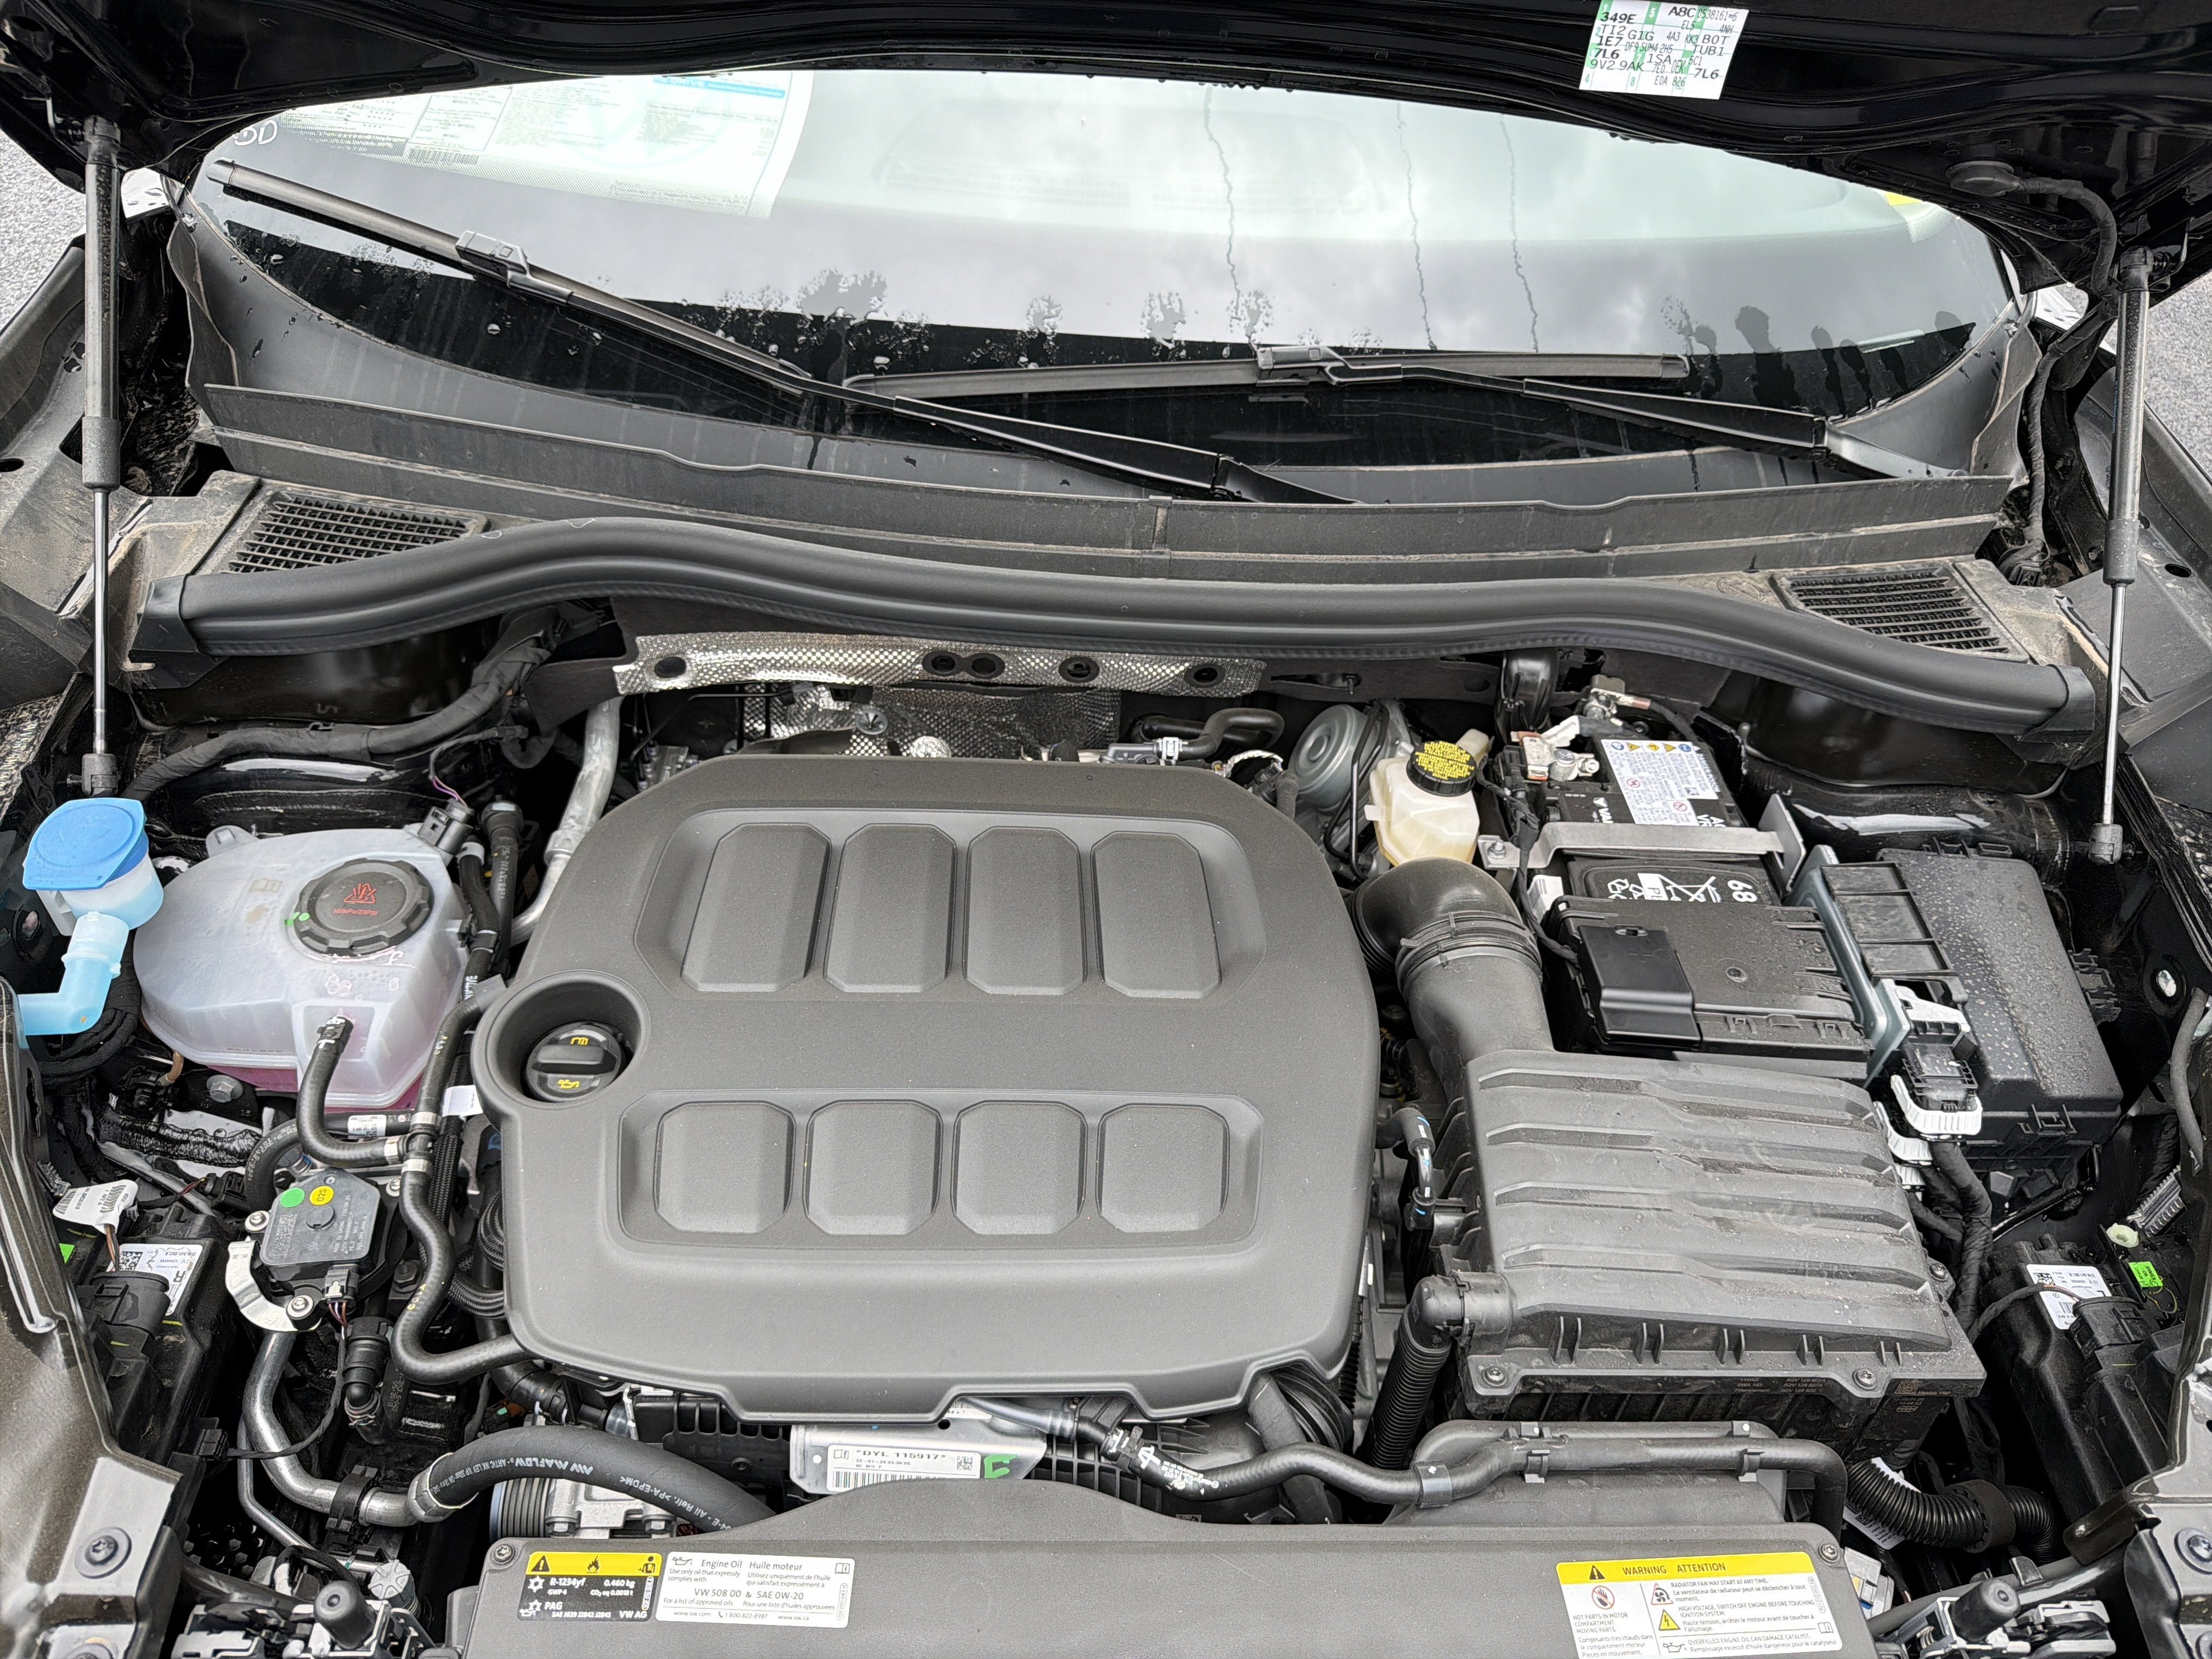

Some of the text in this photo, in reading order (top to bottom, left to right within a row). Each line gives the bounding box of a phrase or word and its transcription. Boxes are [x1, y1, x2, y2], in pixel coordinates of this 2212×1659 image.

[1600, 12, 1637, 24] 349E
[1668, 6, 1696, 18] A8C
[1596, 35, 1624, 47] 1E7
[1628, 30, 1655, 41] G1G
[1667, 31, 1680, 41] 4A3
[1684, 34, 1699, 44] KK3
[1594, 48, 1620, 59] 7L6
[1590, 59, 1615, 70] 9V2
[1619, 60, 1644, 72] 9AK
[1694, 67, 1720, 79] 7L6
[1727, 879, 1758, 902] 68
[673, 1498, 693, 1512] Refr.
[693, 1507, 708, 1518] All
[701, 1559, 729, 1570] Engine
[749, 1561, 770, 1570] Huile
[1622, 1562, 1726, 1576] WARNING ATTENTION
[550, 1577, 586, 1588] R-1234yf
[625, 1579, 635, 1588] kg
[770, 1573, 804, 1582] uniquement
[712, 1589, 727, 1597] 508
[775, 1592, 804, 1600] 0W-20
[545, 1602, 563, 1610] PAG
